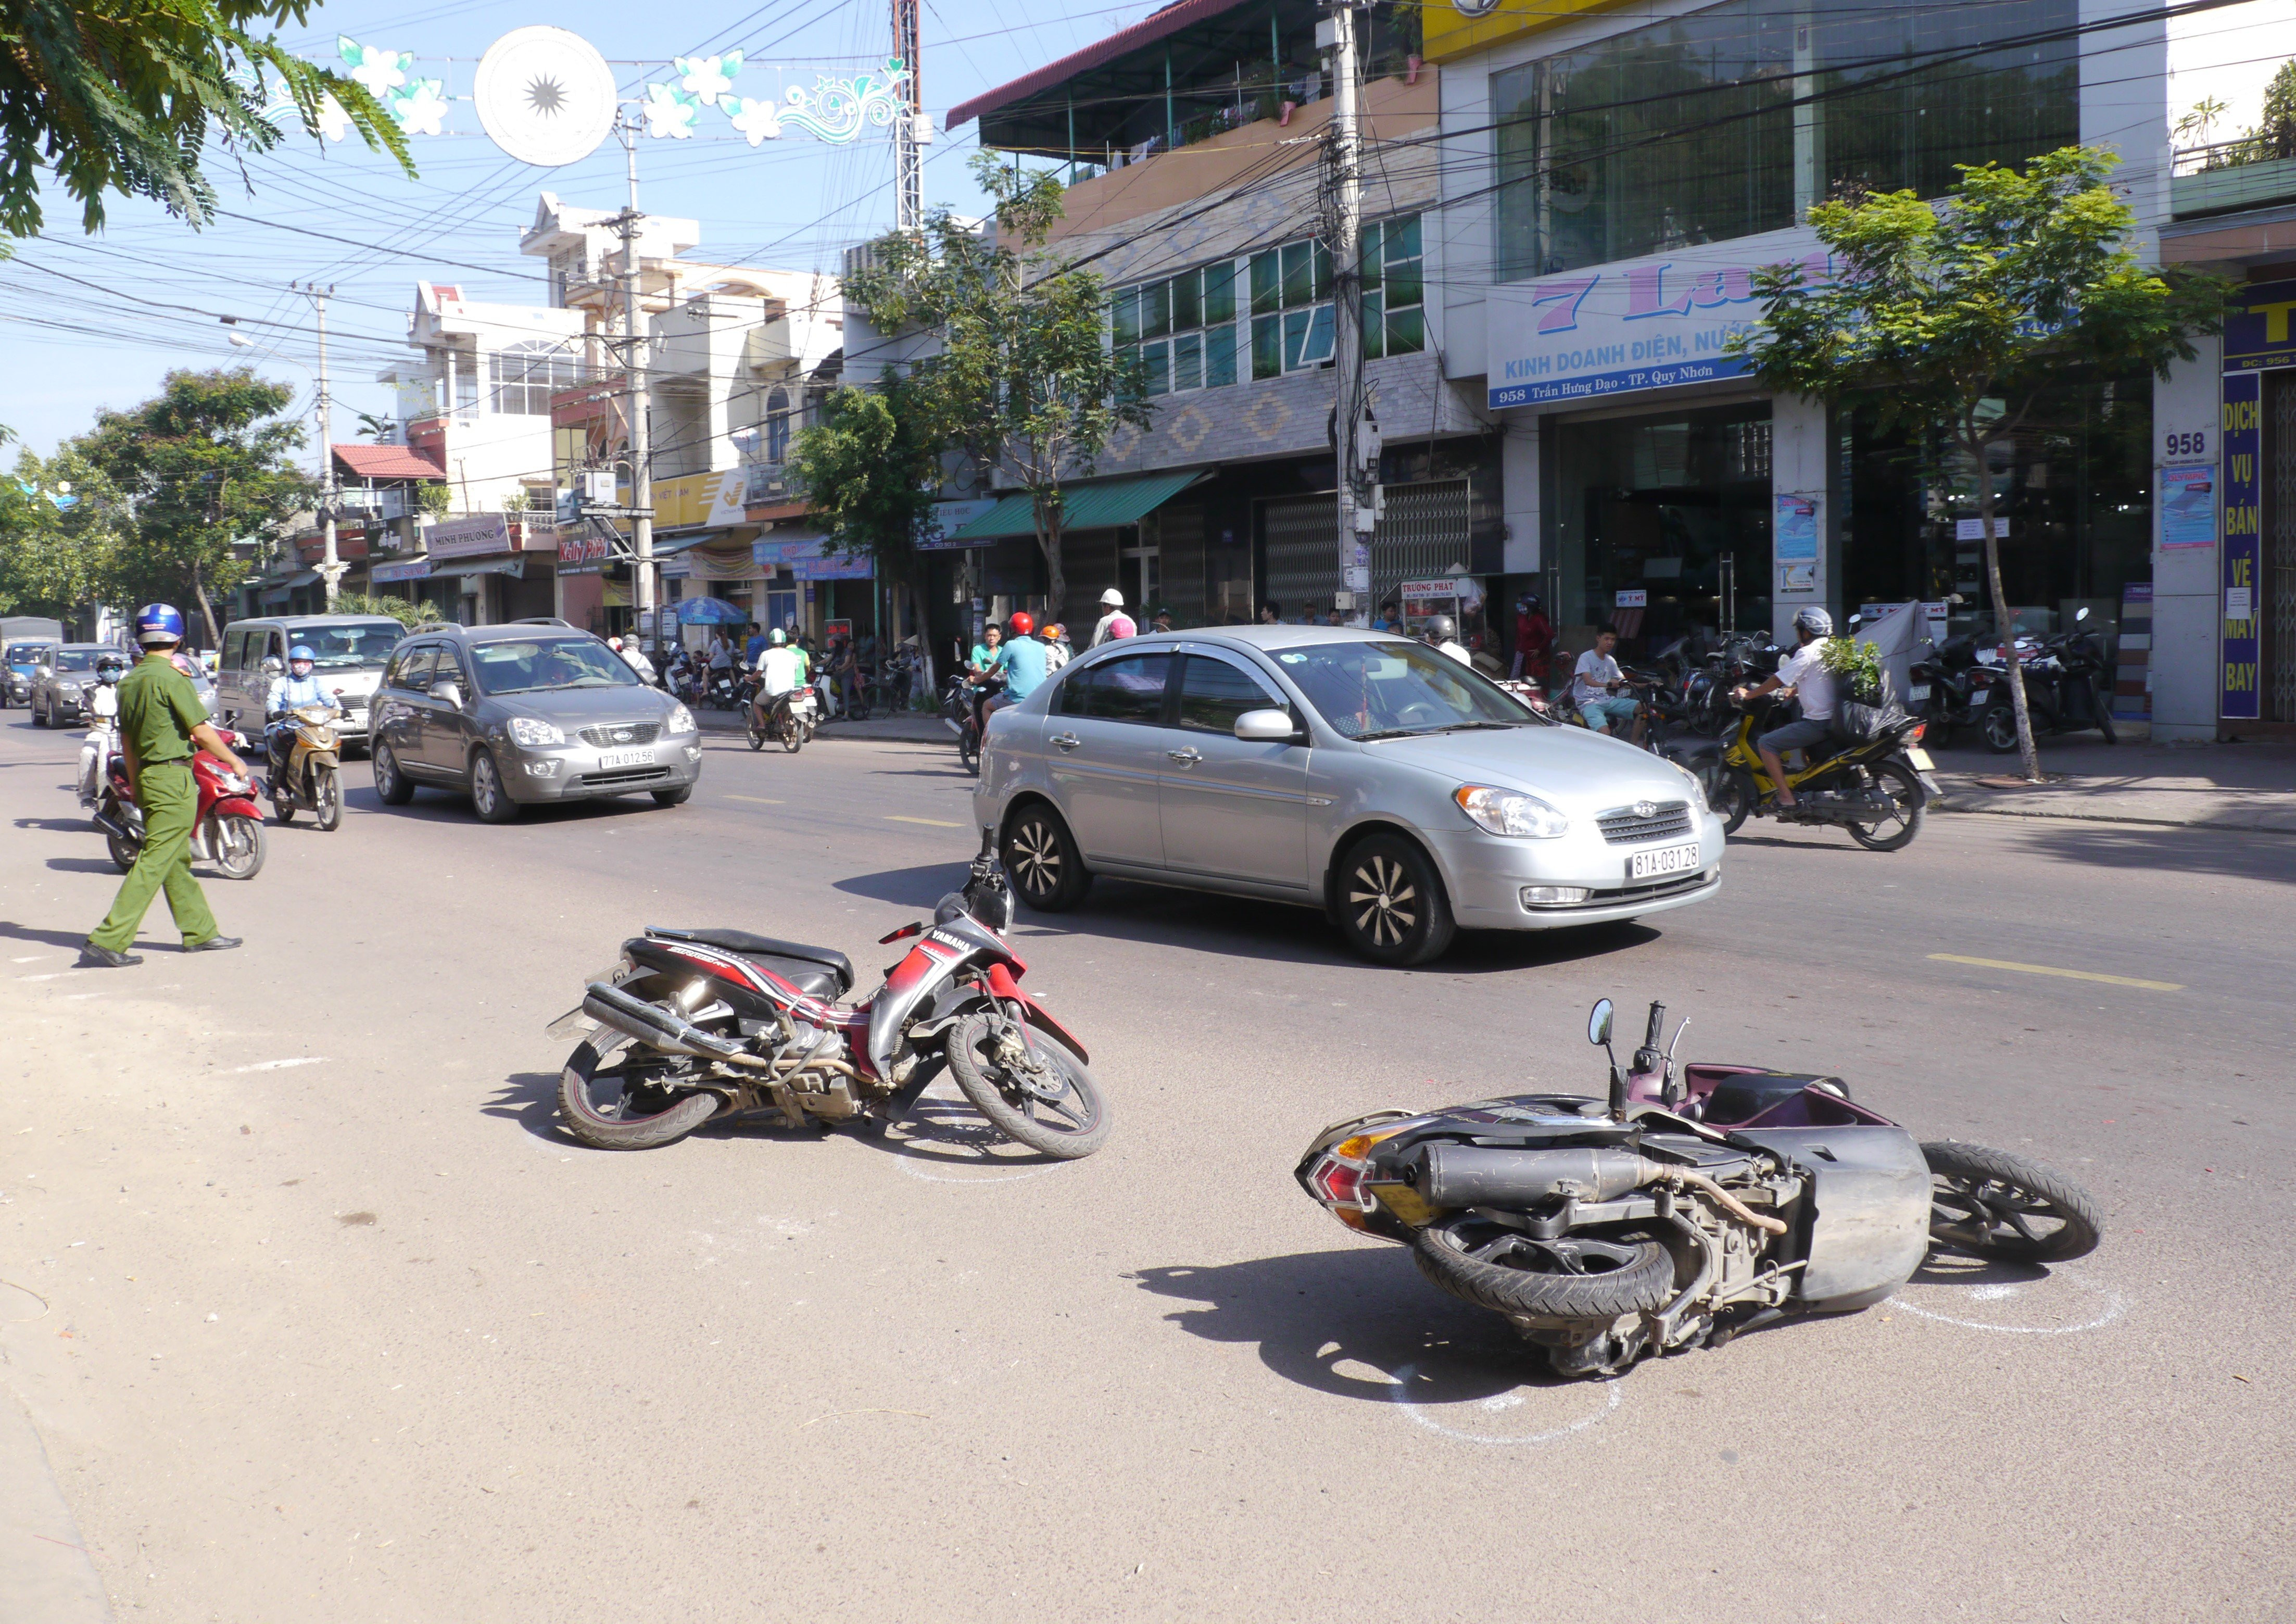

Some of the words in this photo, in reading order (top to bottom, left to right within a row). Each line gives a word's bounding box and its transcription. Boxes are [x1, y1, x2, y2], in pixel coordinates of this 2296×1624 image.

[1532, 274, 1600, 334] 7
[1506, 356, 1550, 379] KINH
[1557, 345, 1624, 372] DOANH
[1631, 334, 1687, 364] ĐIỆN,
[2266, 356, 2290, 364] 956
[1499, 389, 1525, 404] 958
[1532, 381, 1559, 399] Trần
[1562, 381, 1592, 398] Hưng
[1595, 377, 1618, 394] Đạo
[1629, 373, 1648, 386] TP.
[1651, 369, 1676, 387] Quy
[1680, 364, 1713, 380] Nhơn
[2224, 401, 2259, 437] DỊCH
[2167, 432, 2204, 456] 958
[2168, 471, 2207, 482] OLYMPIC
[2232, 454, 2252, 488] VỤ
[660, 488, 672, 500] VIỆT
[2227, 498, 2257, 535] BÁN
[435, 535, 456, 546] MINH
[458, 530, 494, 543] PHƯƠNG
[559, 540, 585, 564] Kelly
[2232, 550, 2251, 587] VÉ
[1403, 582, 1431, 592] TRƯỜNG
[1434, 580, 1453, 590] PHÁT
[2226, 663, 2256, 691] BAY
[932, 930, 970, 953] YAMAHA
[667, 946, 718, 963] SIRIUS
